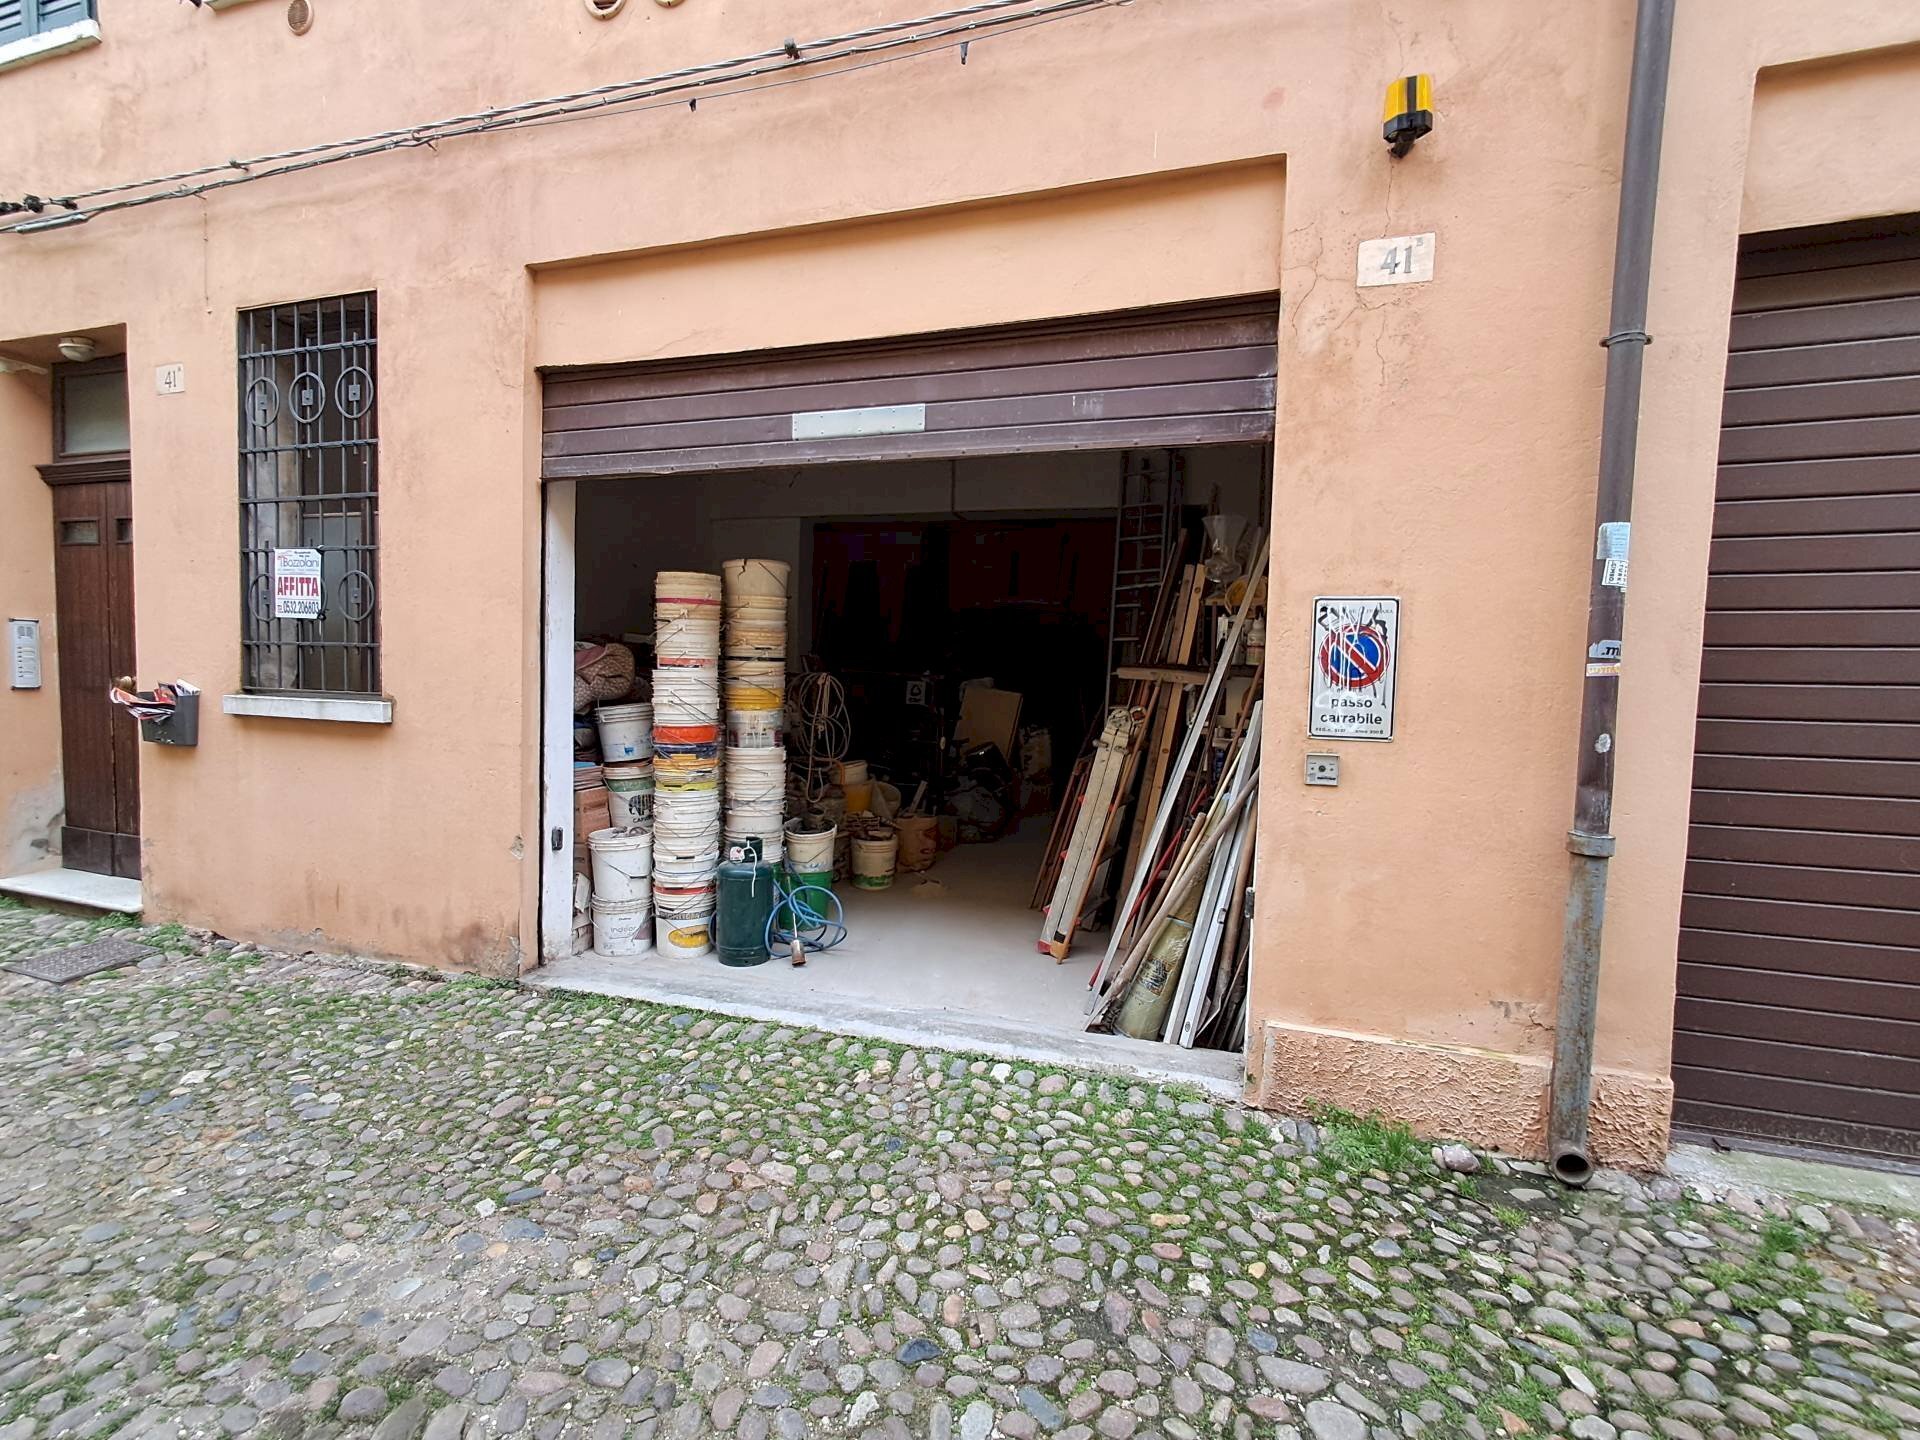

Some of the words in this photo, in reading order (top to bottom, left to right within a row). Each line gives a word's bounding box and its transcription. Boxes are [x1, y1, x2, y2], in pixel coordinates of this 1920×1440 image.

[1380, 245, 1413, 275] 41
[277, 576, 319, 597] AFFITTA
[1330, 697, 1373, 709] passo
[1320, 713, 1383, 725] carrabile
